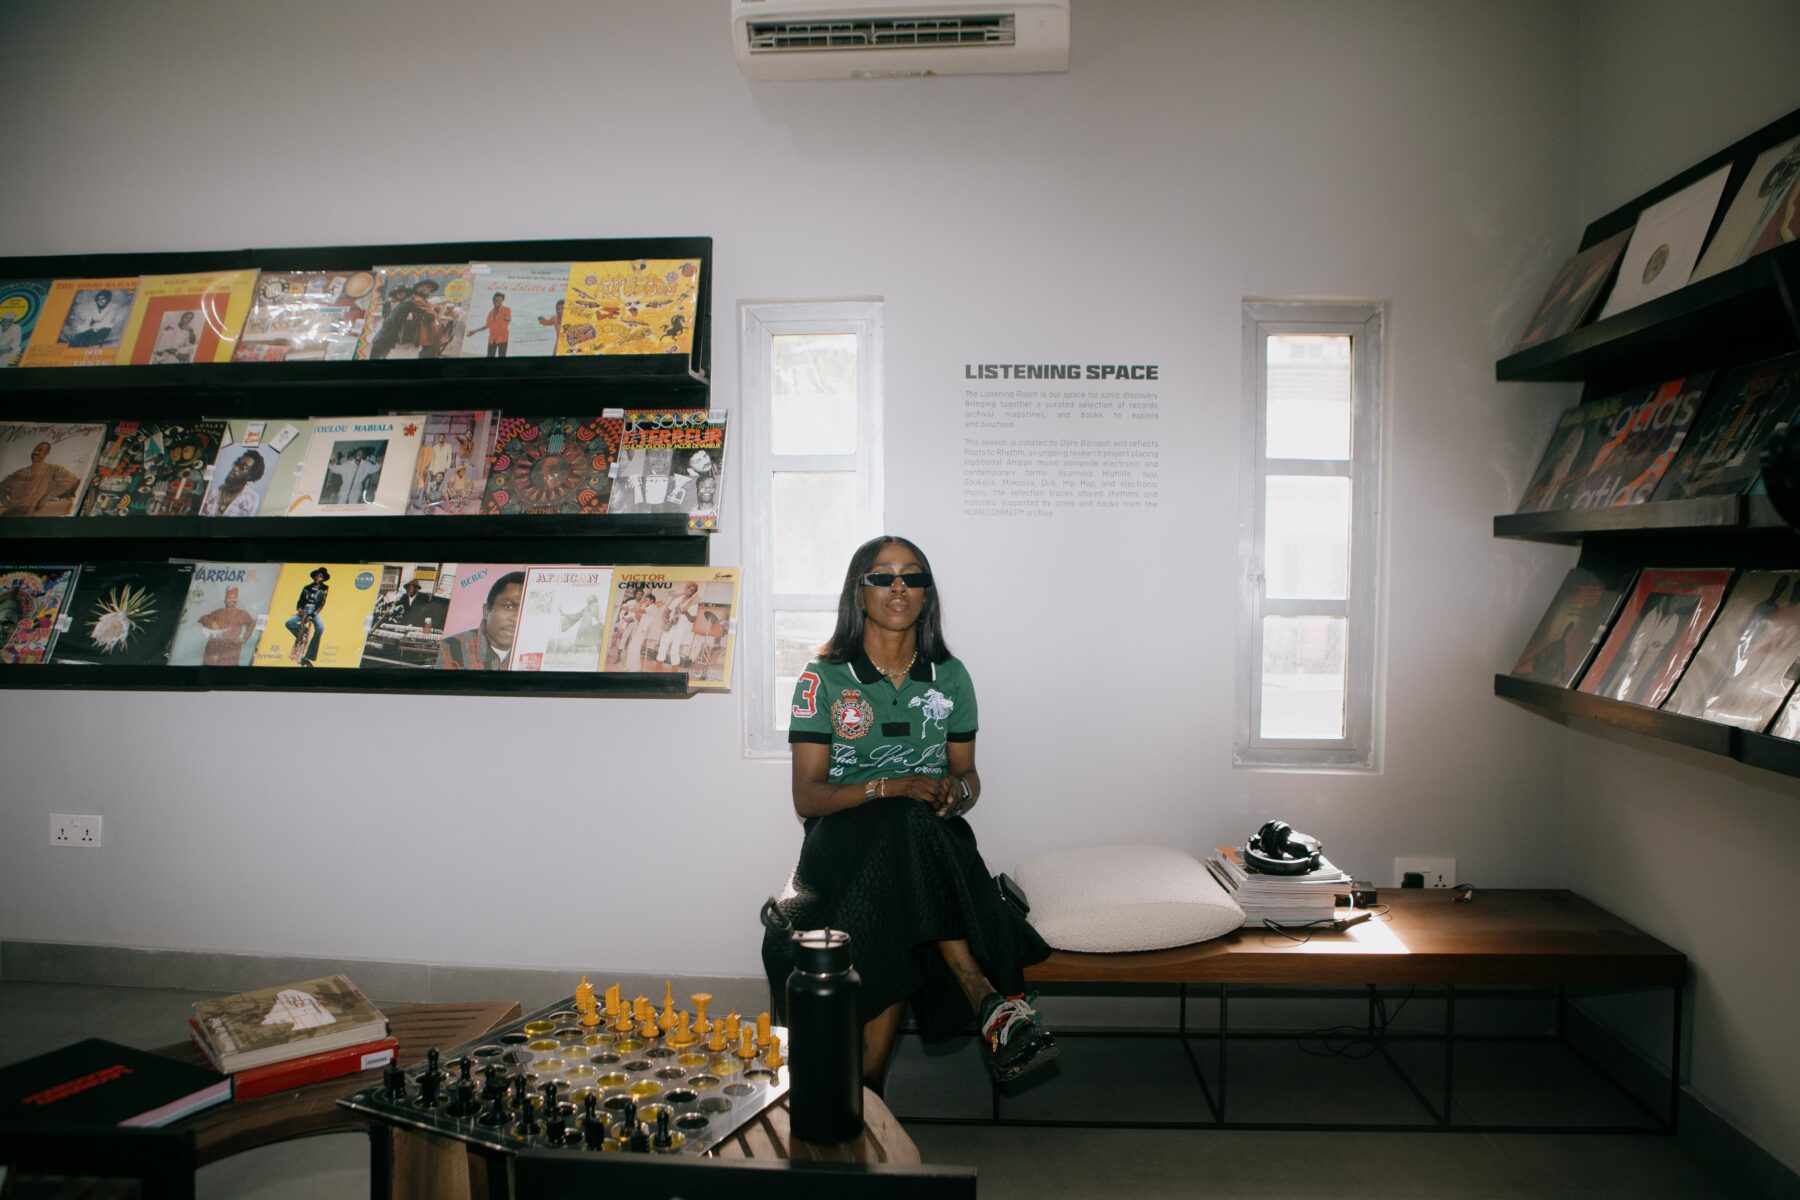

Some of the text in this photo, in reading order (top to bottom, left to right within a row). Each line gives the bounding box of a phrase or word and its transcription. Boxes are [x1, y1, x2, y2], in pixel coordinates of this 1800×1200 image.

[965, 364, 1159, 380] LISTENING SPACE
[965, 390, 978, 398] The
[980, 390, 1014, 399] Listening
[1016, 390, 1038, 399] Room
[1063, 392, 1086, 400] space
[1101, 391, 1121, 399] sonic
[964, 400, 996, 409] Bringing
[1000, 401, 1032, 409] together
[1045, 401, 1074, 409] curated
[1078, 401, 1113, 409] selection
[1609, 390, 1703, 438] atlas
[353, 424, 394, 433] MABIALA
[640, 428, 722, 445] TERREUR
[964, 438, 979, 446] This
[1103, 450, 1130, 459] project
[1006, 459, 1033, 467] African
[460, 568, 488, 588] BEBEY
[535, 572, 599, 584] AFRICAN
[620, 573, 666, 581] VICTOR
[618, 582, 673, 590] CHUKWU
[792, 672, 820, 717] 3
